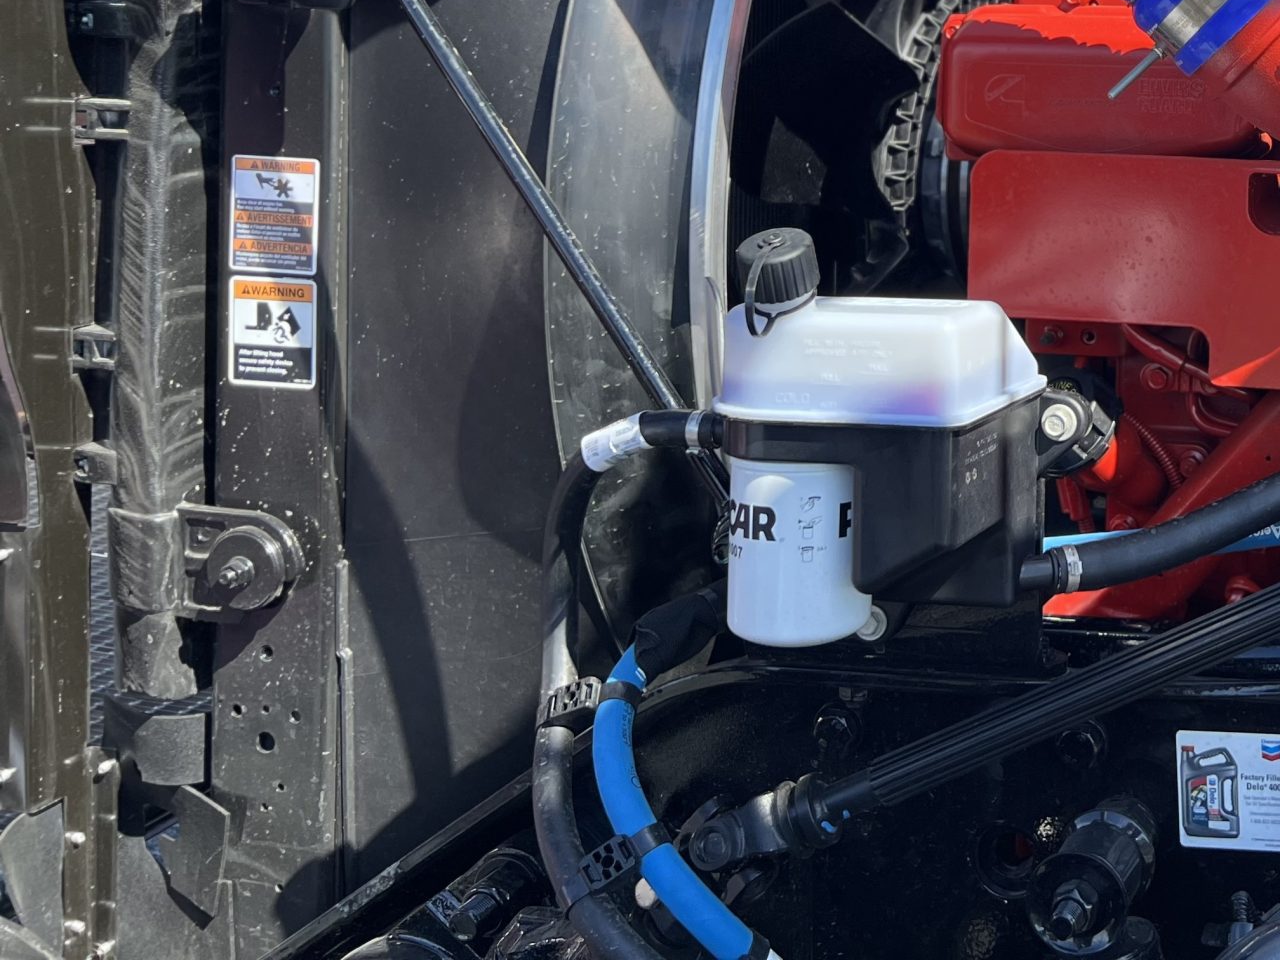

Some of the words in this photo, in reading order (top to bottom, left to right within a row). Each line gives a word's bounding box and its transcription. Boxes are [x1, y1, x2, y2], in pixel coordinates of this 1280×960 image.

[261, 160, 300, 172] WARNING
[248, 212, 311, 225] AVERTISSEMENT
[251, 241, 308, 253] ADVERTENCIA
[251, 286, 304, 298] WARNING
[1240, 773, 1264, 782] Factory
[1208, 788, 1216, 805] Delo
